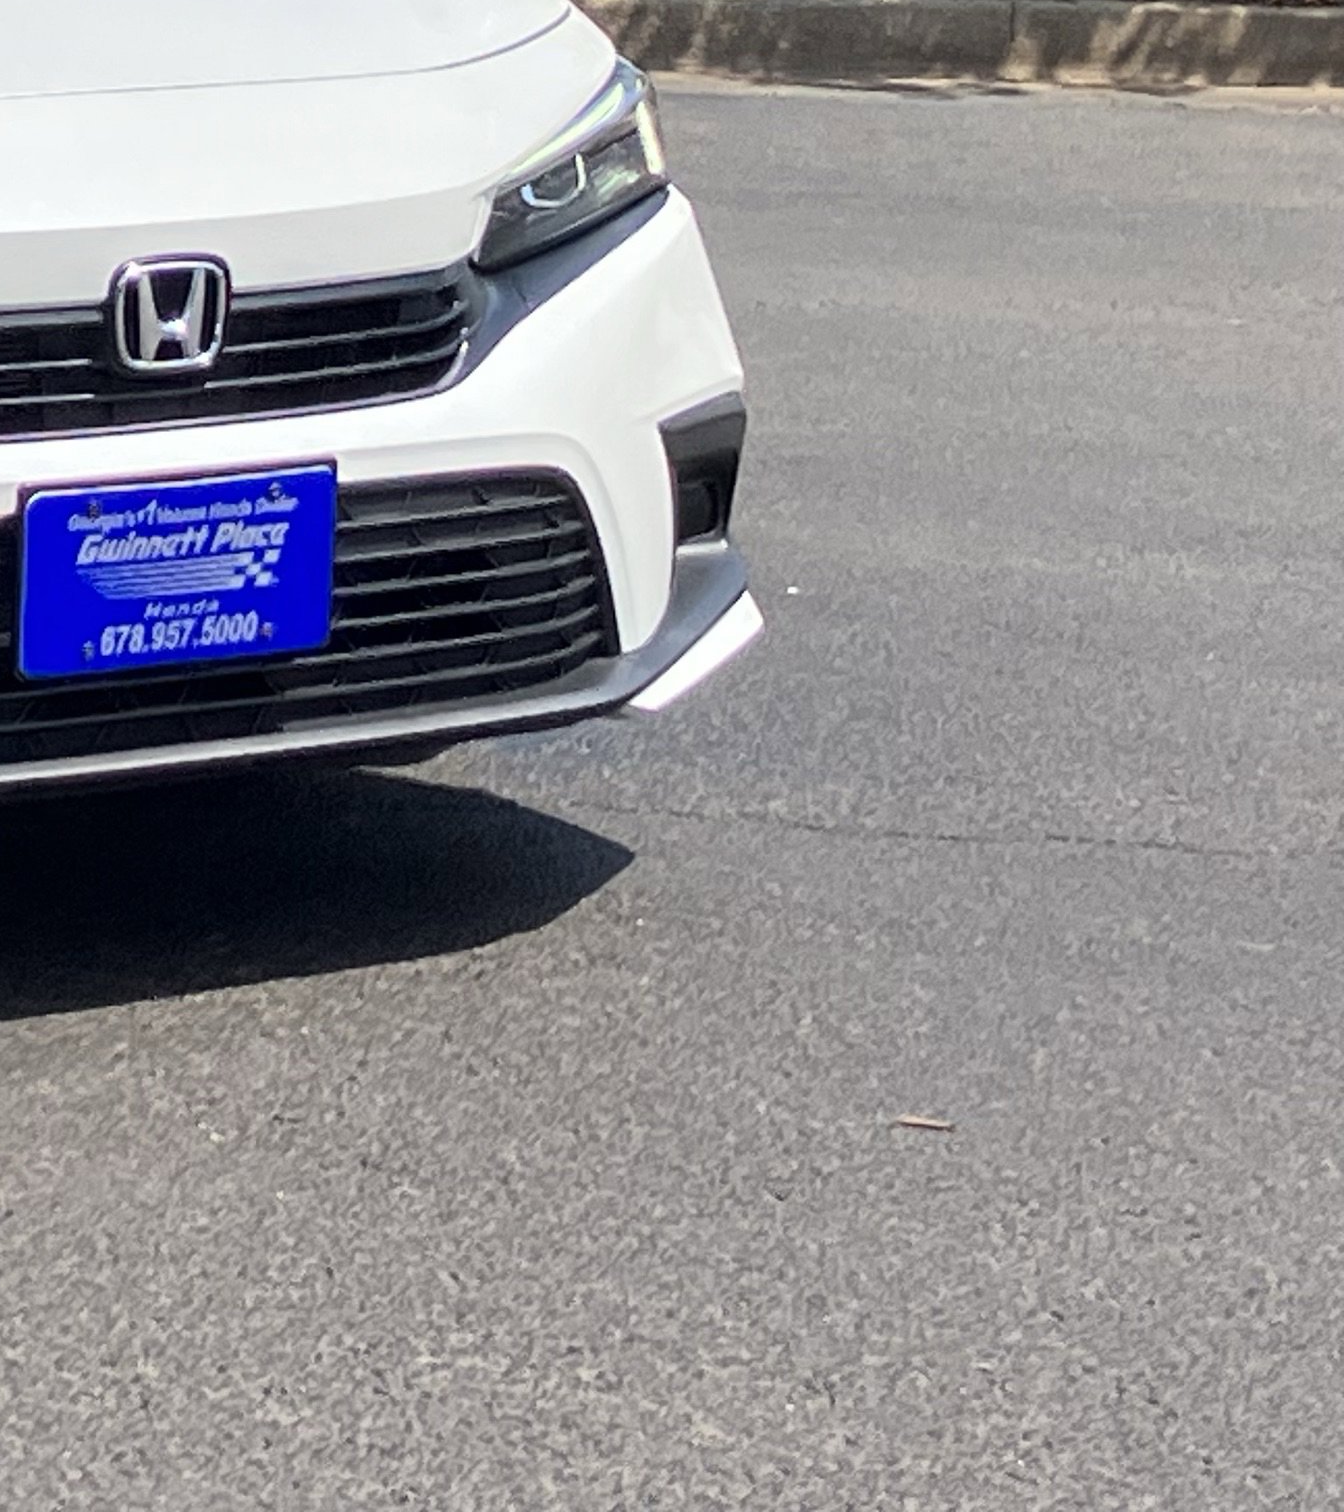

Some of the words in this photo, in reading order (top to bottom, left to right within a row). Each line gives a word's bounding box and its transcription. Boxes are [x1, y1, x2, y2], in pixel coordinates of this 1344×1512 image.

[76, 525, 209, 565] Gwinnett
[210, 520, 290, 553] Place
[144, 600, 220, 620] Honda
[99, 610, 259, 657] 678.957.5000
